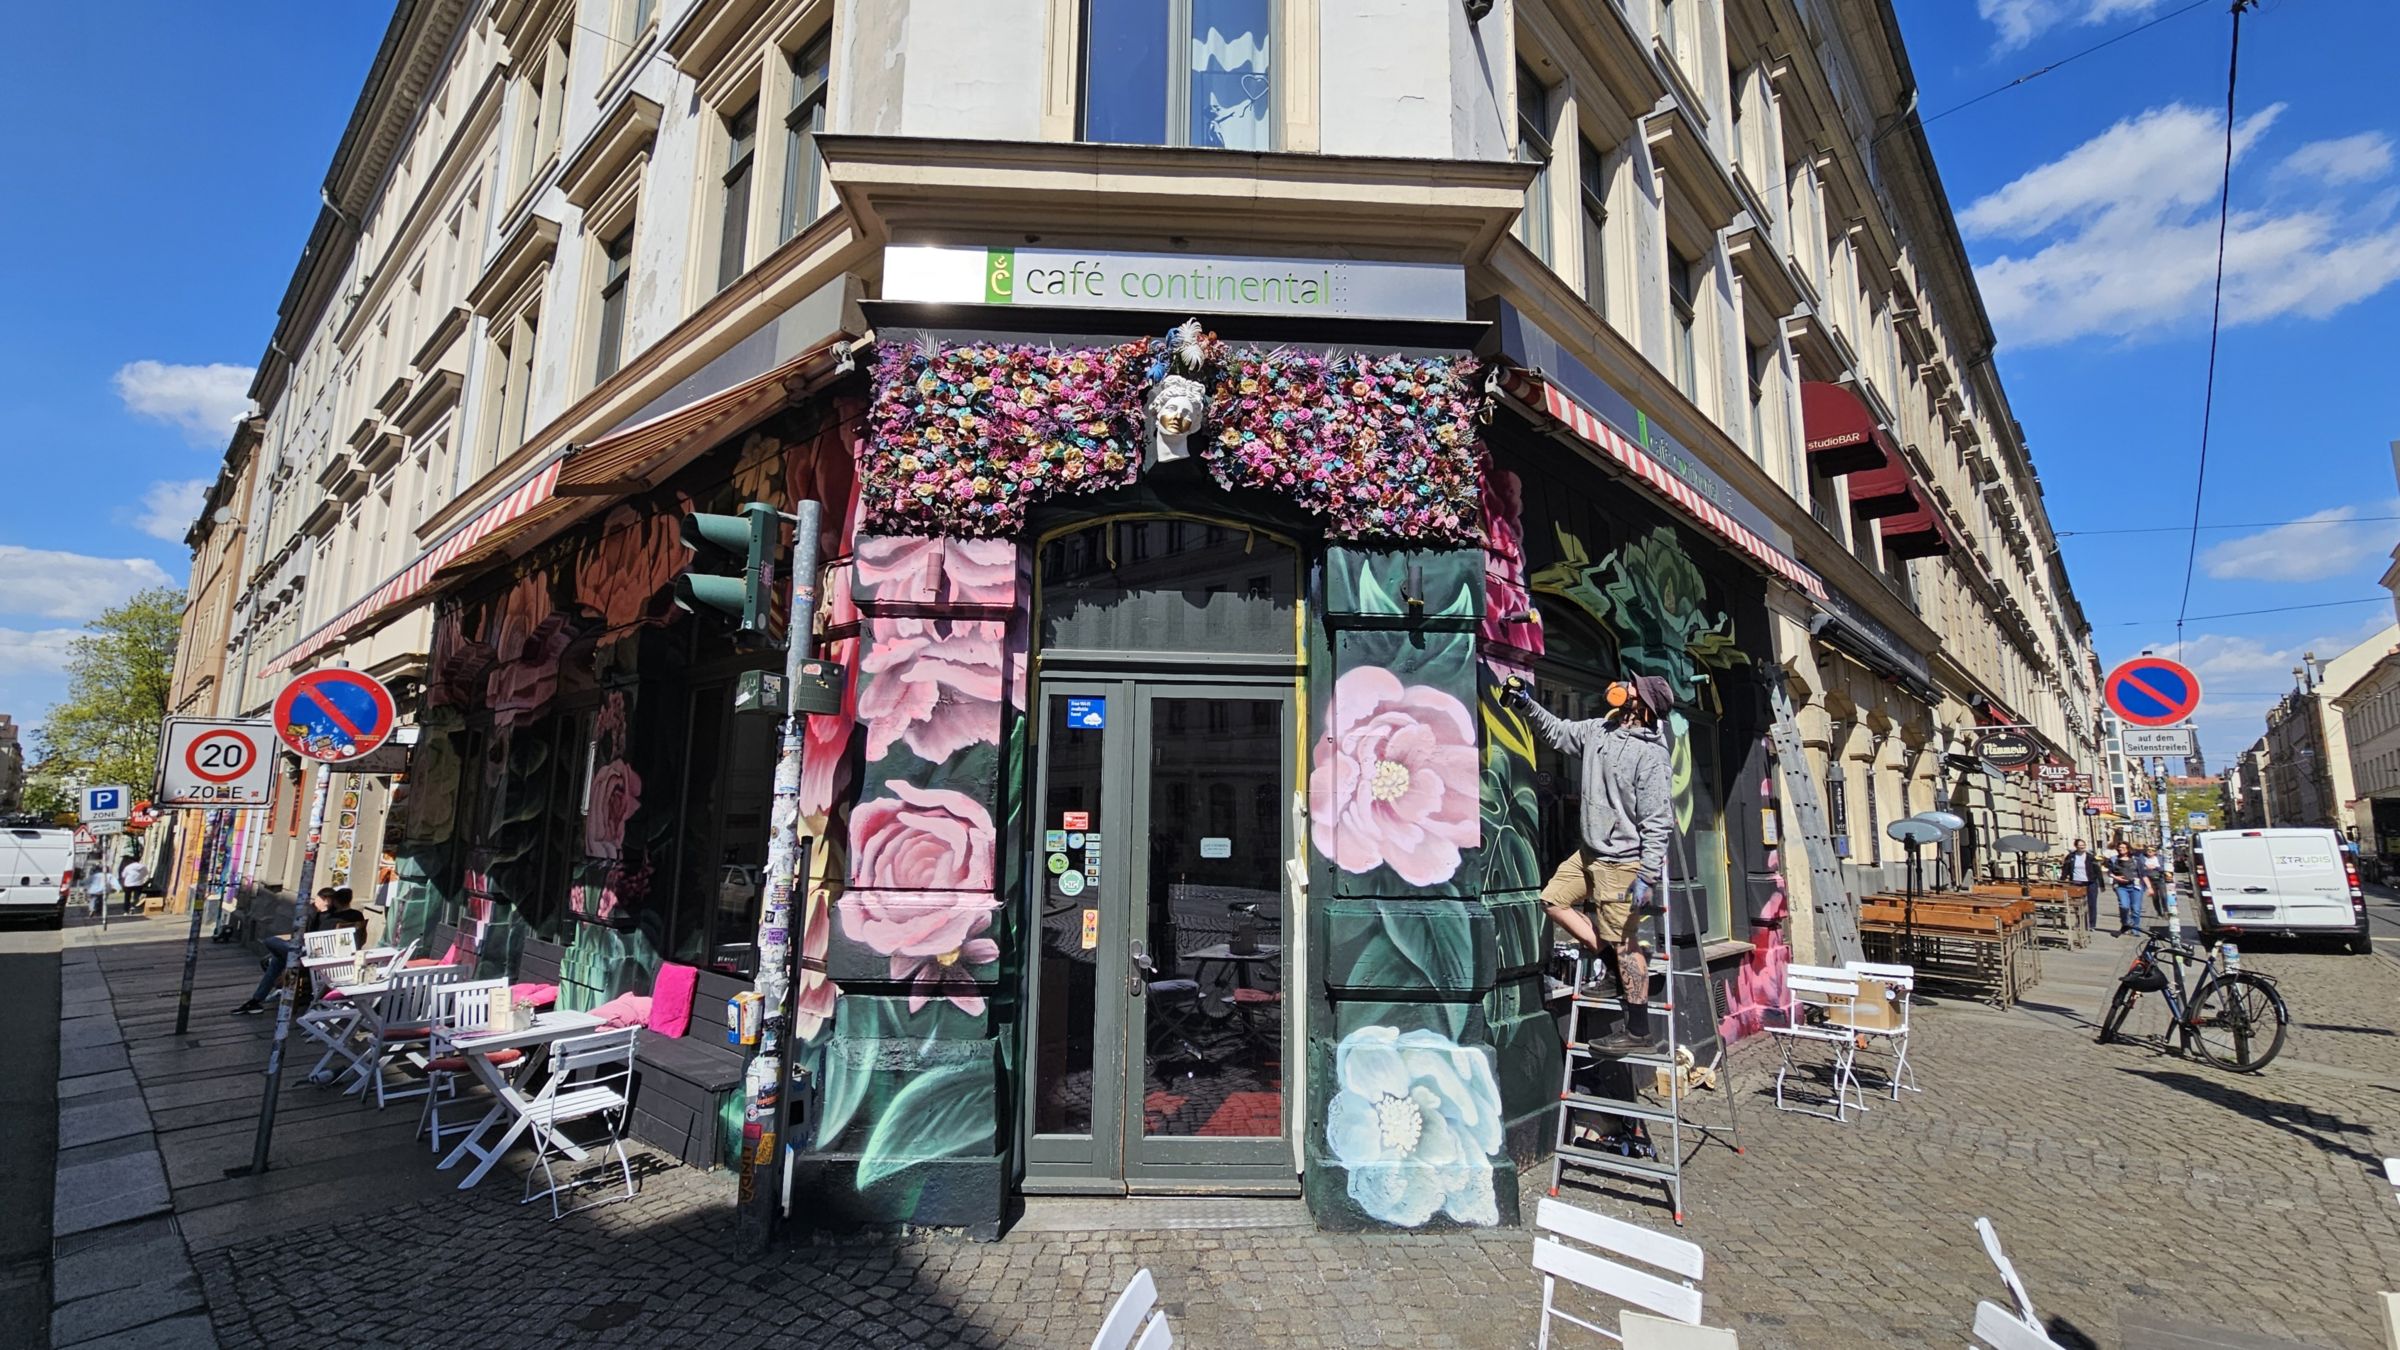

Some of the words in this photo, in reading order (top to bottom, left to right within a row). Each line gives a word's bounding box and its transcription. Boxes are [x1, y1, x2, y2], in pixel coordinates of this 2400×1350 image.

[1026, 261, 1104, 296] café
[1121, 265, 1330, 303] continental
[1808, 432, 1860, 450] studioBAR
[745, 620, 752, 630] 3
[2128, 743, 2187, 752] Seitenstreifen
[201, 744, 242, 768] 20
[189, 785, 244, 799] ZOE
[97, 792, 112, 809] P
[2137, 801, 2148, 812] P
[93, 811, 118, 819] ZONE
